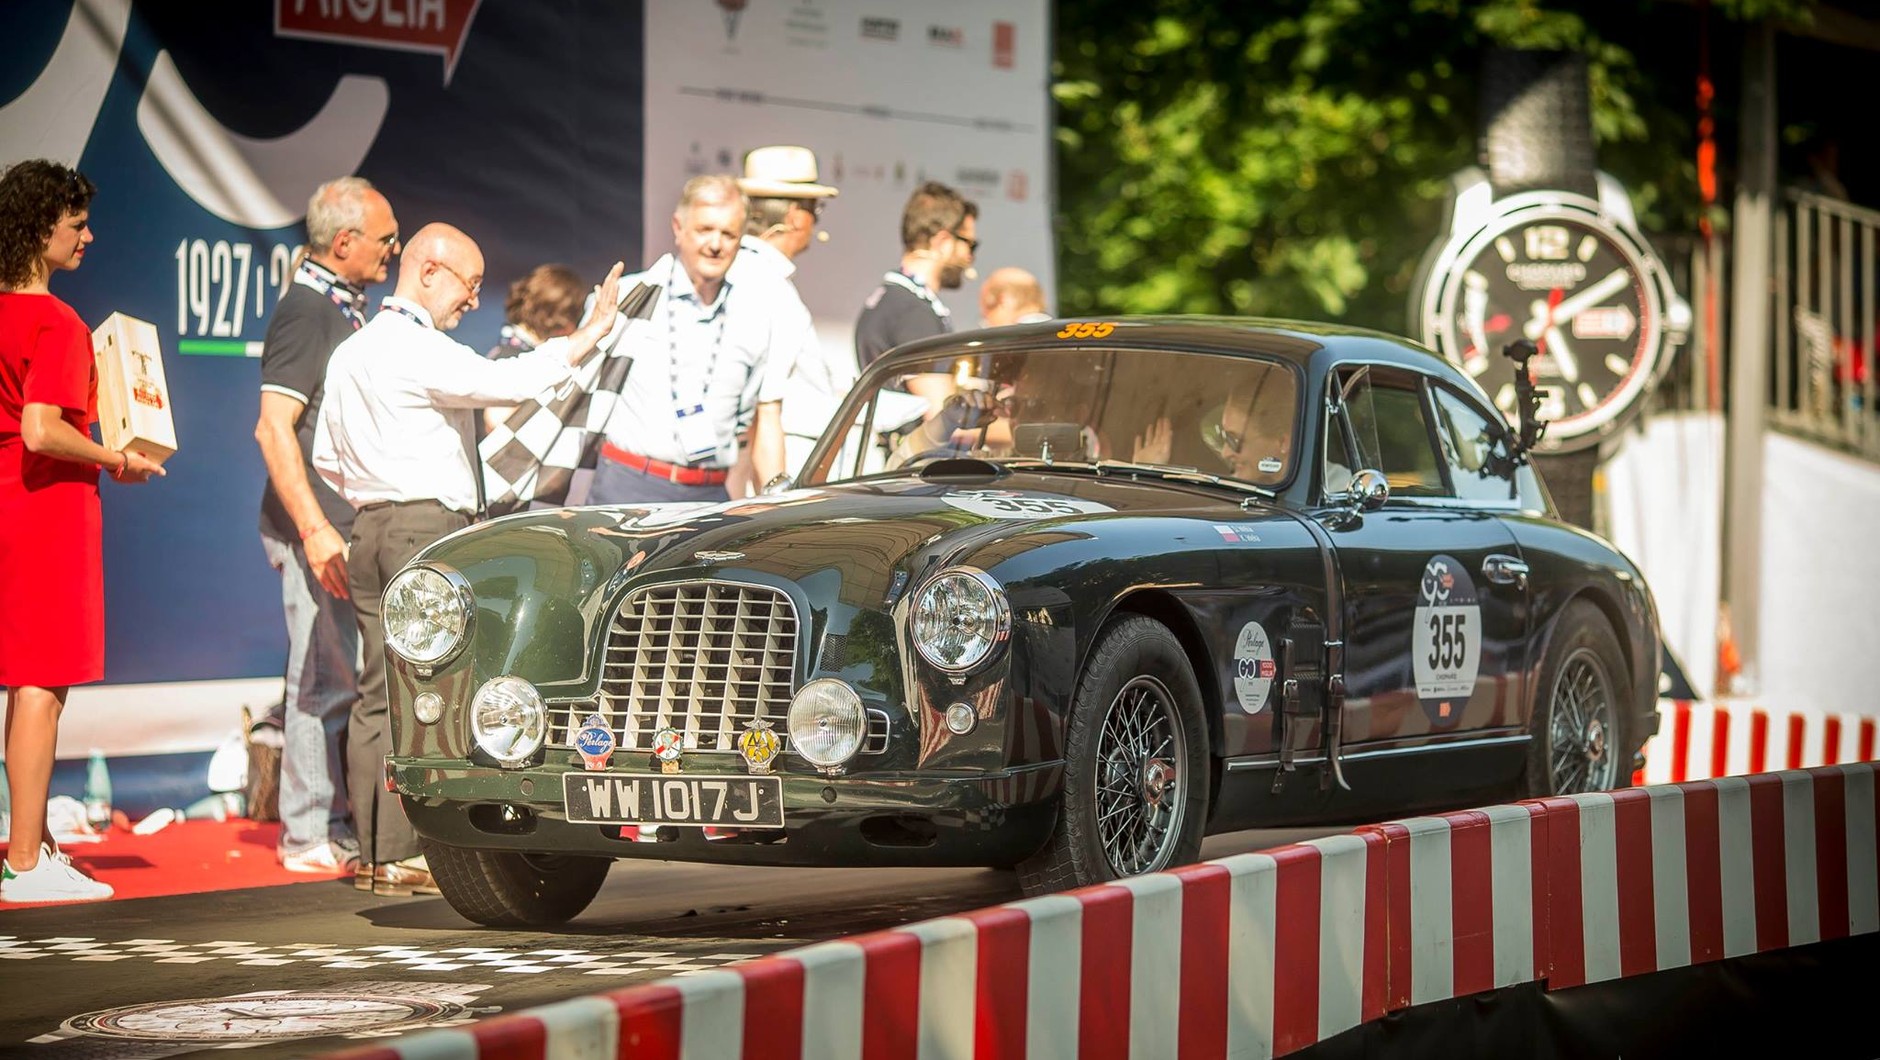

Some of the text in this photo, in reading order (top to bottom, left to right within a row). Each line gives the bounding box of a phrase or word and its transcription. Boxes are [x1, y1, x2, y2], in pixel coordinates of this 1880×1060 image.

[1524, 226, 1569, 259] 12
[175, 237, 303, 338] 1927 2
[1056, 322, 1117, 338] 355
[982, 499, 1084, 514] 355
[1429, 614, 1466, 670] 355
[579, 731, 613, 753] Perlage
[587, 779, 640, 819] WW
